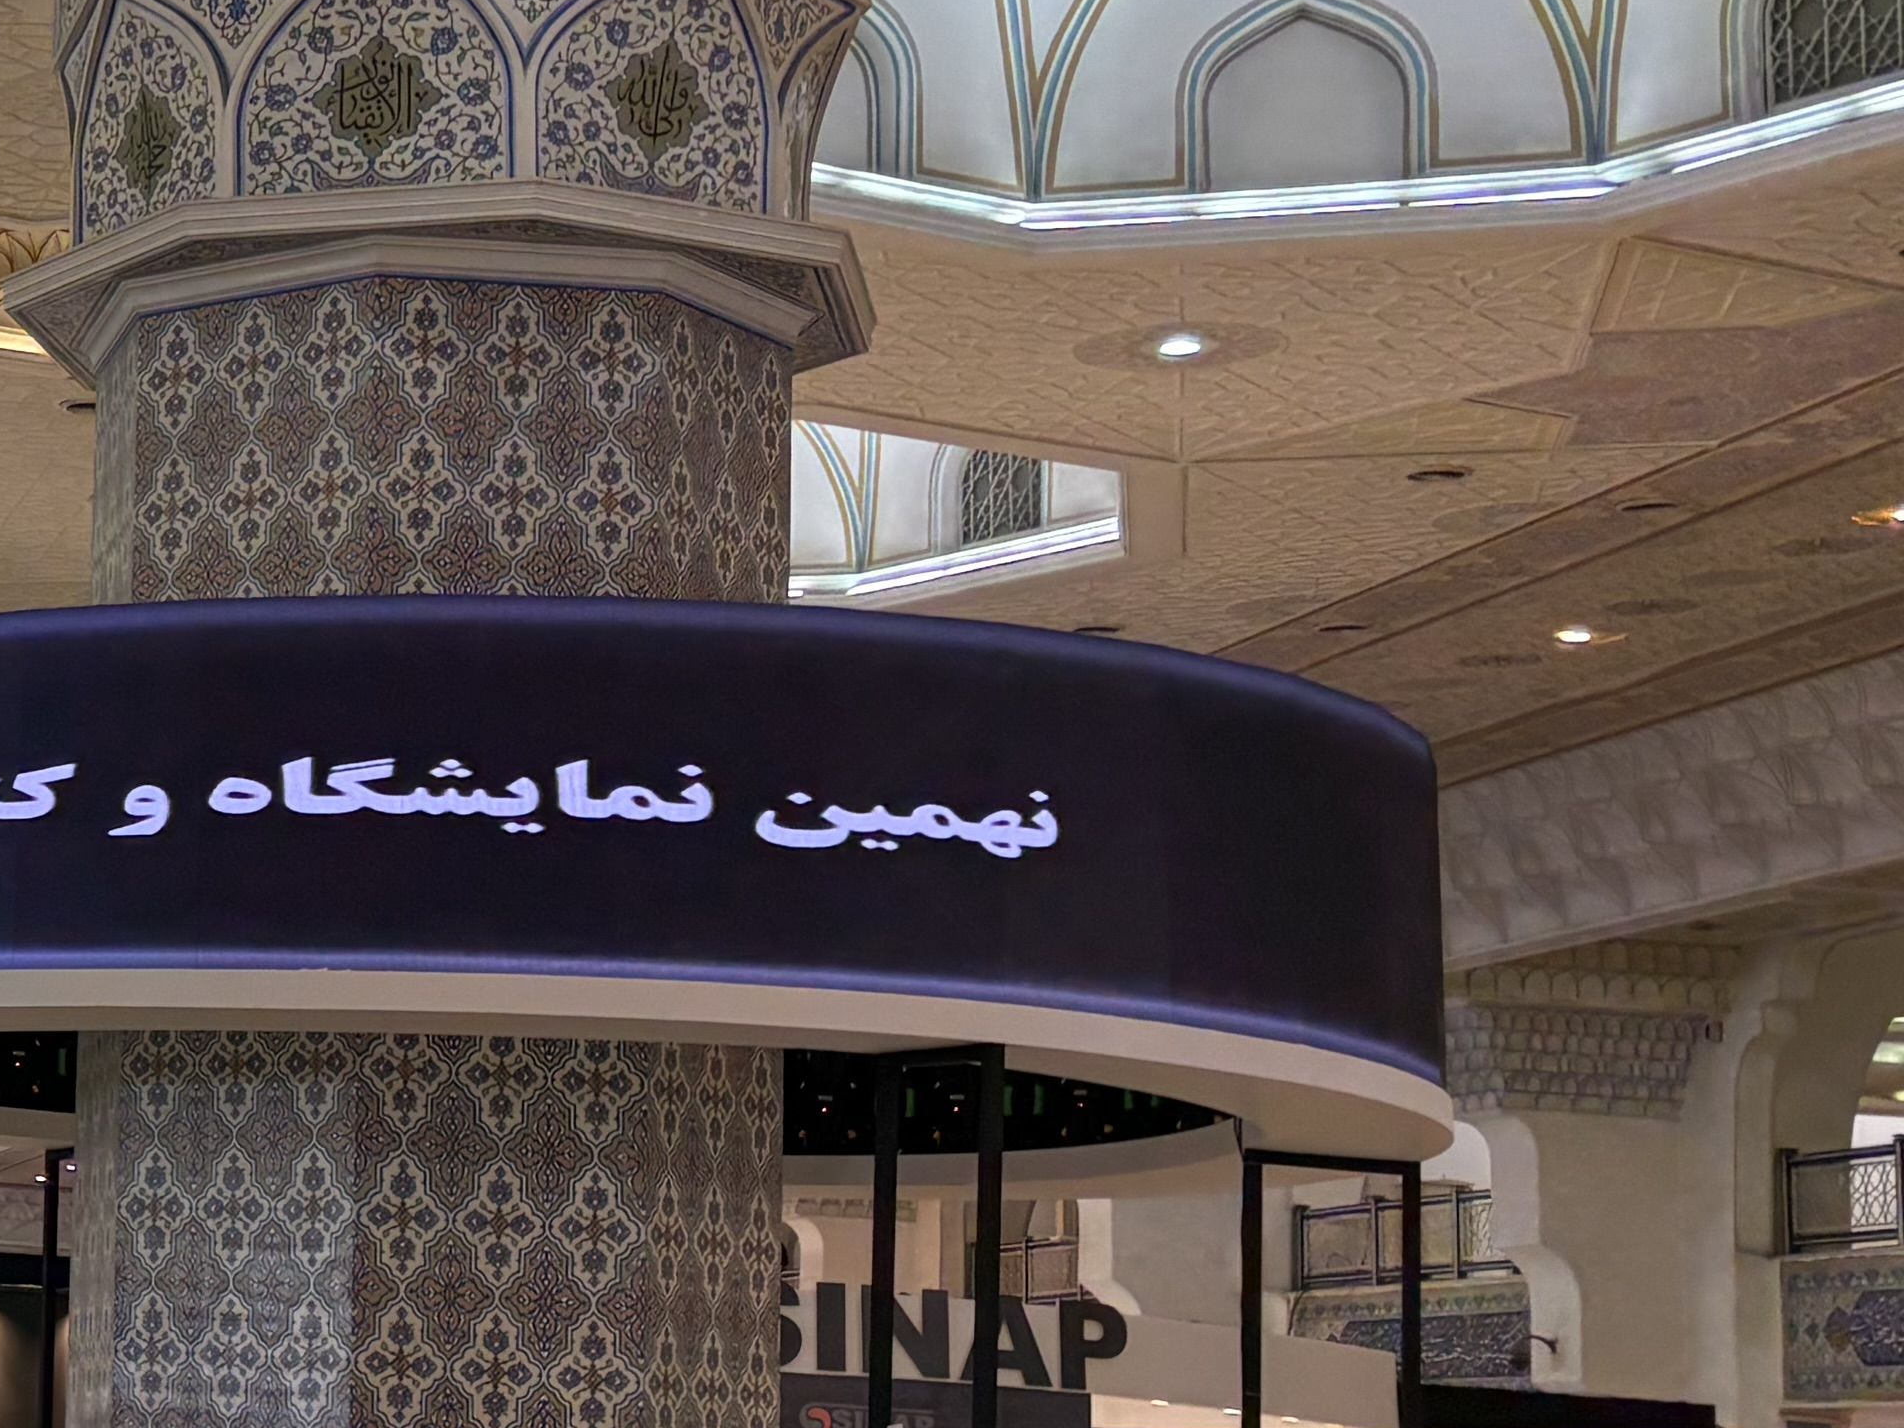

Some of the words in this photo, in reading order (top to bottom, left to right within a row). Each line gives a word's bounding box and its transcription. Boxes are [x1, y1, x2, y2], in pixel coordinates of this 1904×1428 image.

[108, 783, 170, 837] و
[206, 756, 715, 834] نمایشگاه
[753, 788, 1060, 860] نهمین
